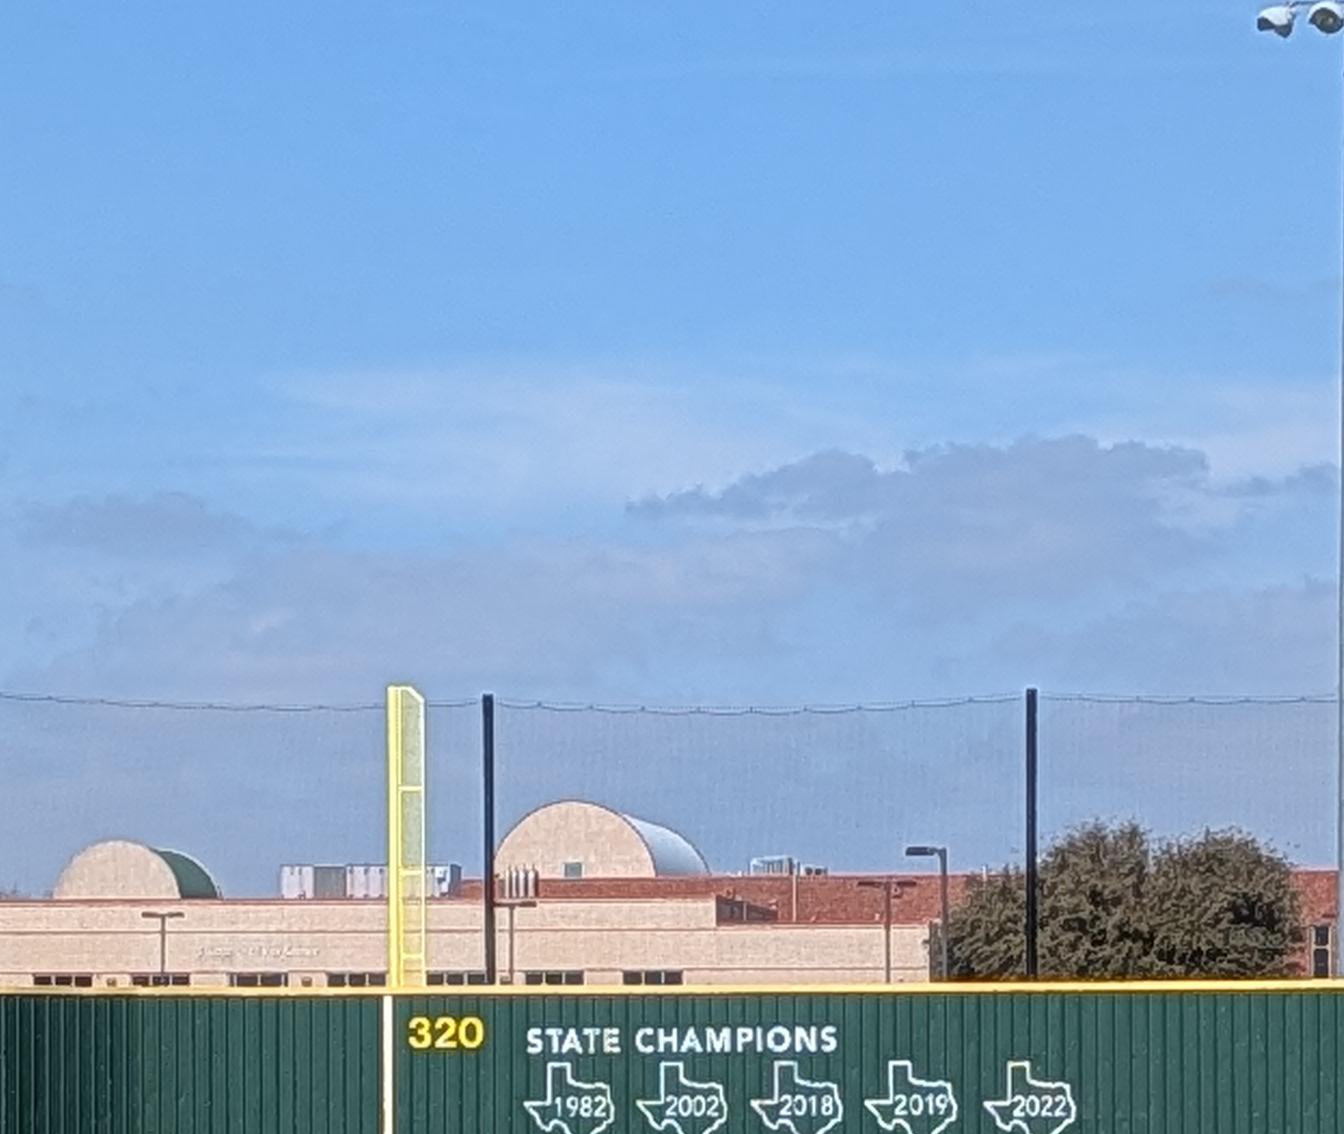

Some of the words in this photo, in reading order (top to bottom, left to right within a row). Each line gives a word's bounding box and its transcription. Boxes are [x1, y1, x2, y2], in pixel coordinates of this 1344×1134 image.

[408, 1016, 485, 1049] 320
[526, 1027, 622, 1054] STATE
[634, 1026, 838, 1054] CHAMPIONS
[555, 1096, 607, 1118] 1982
[665, 1095, 720, 1118] 2002
[778, 1095, 834, 1117] 2018
[893, 1094, 948, 1116] 2019
[1012, 1095, 1068, 1117] 2022
